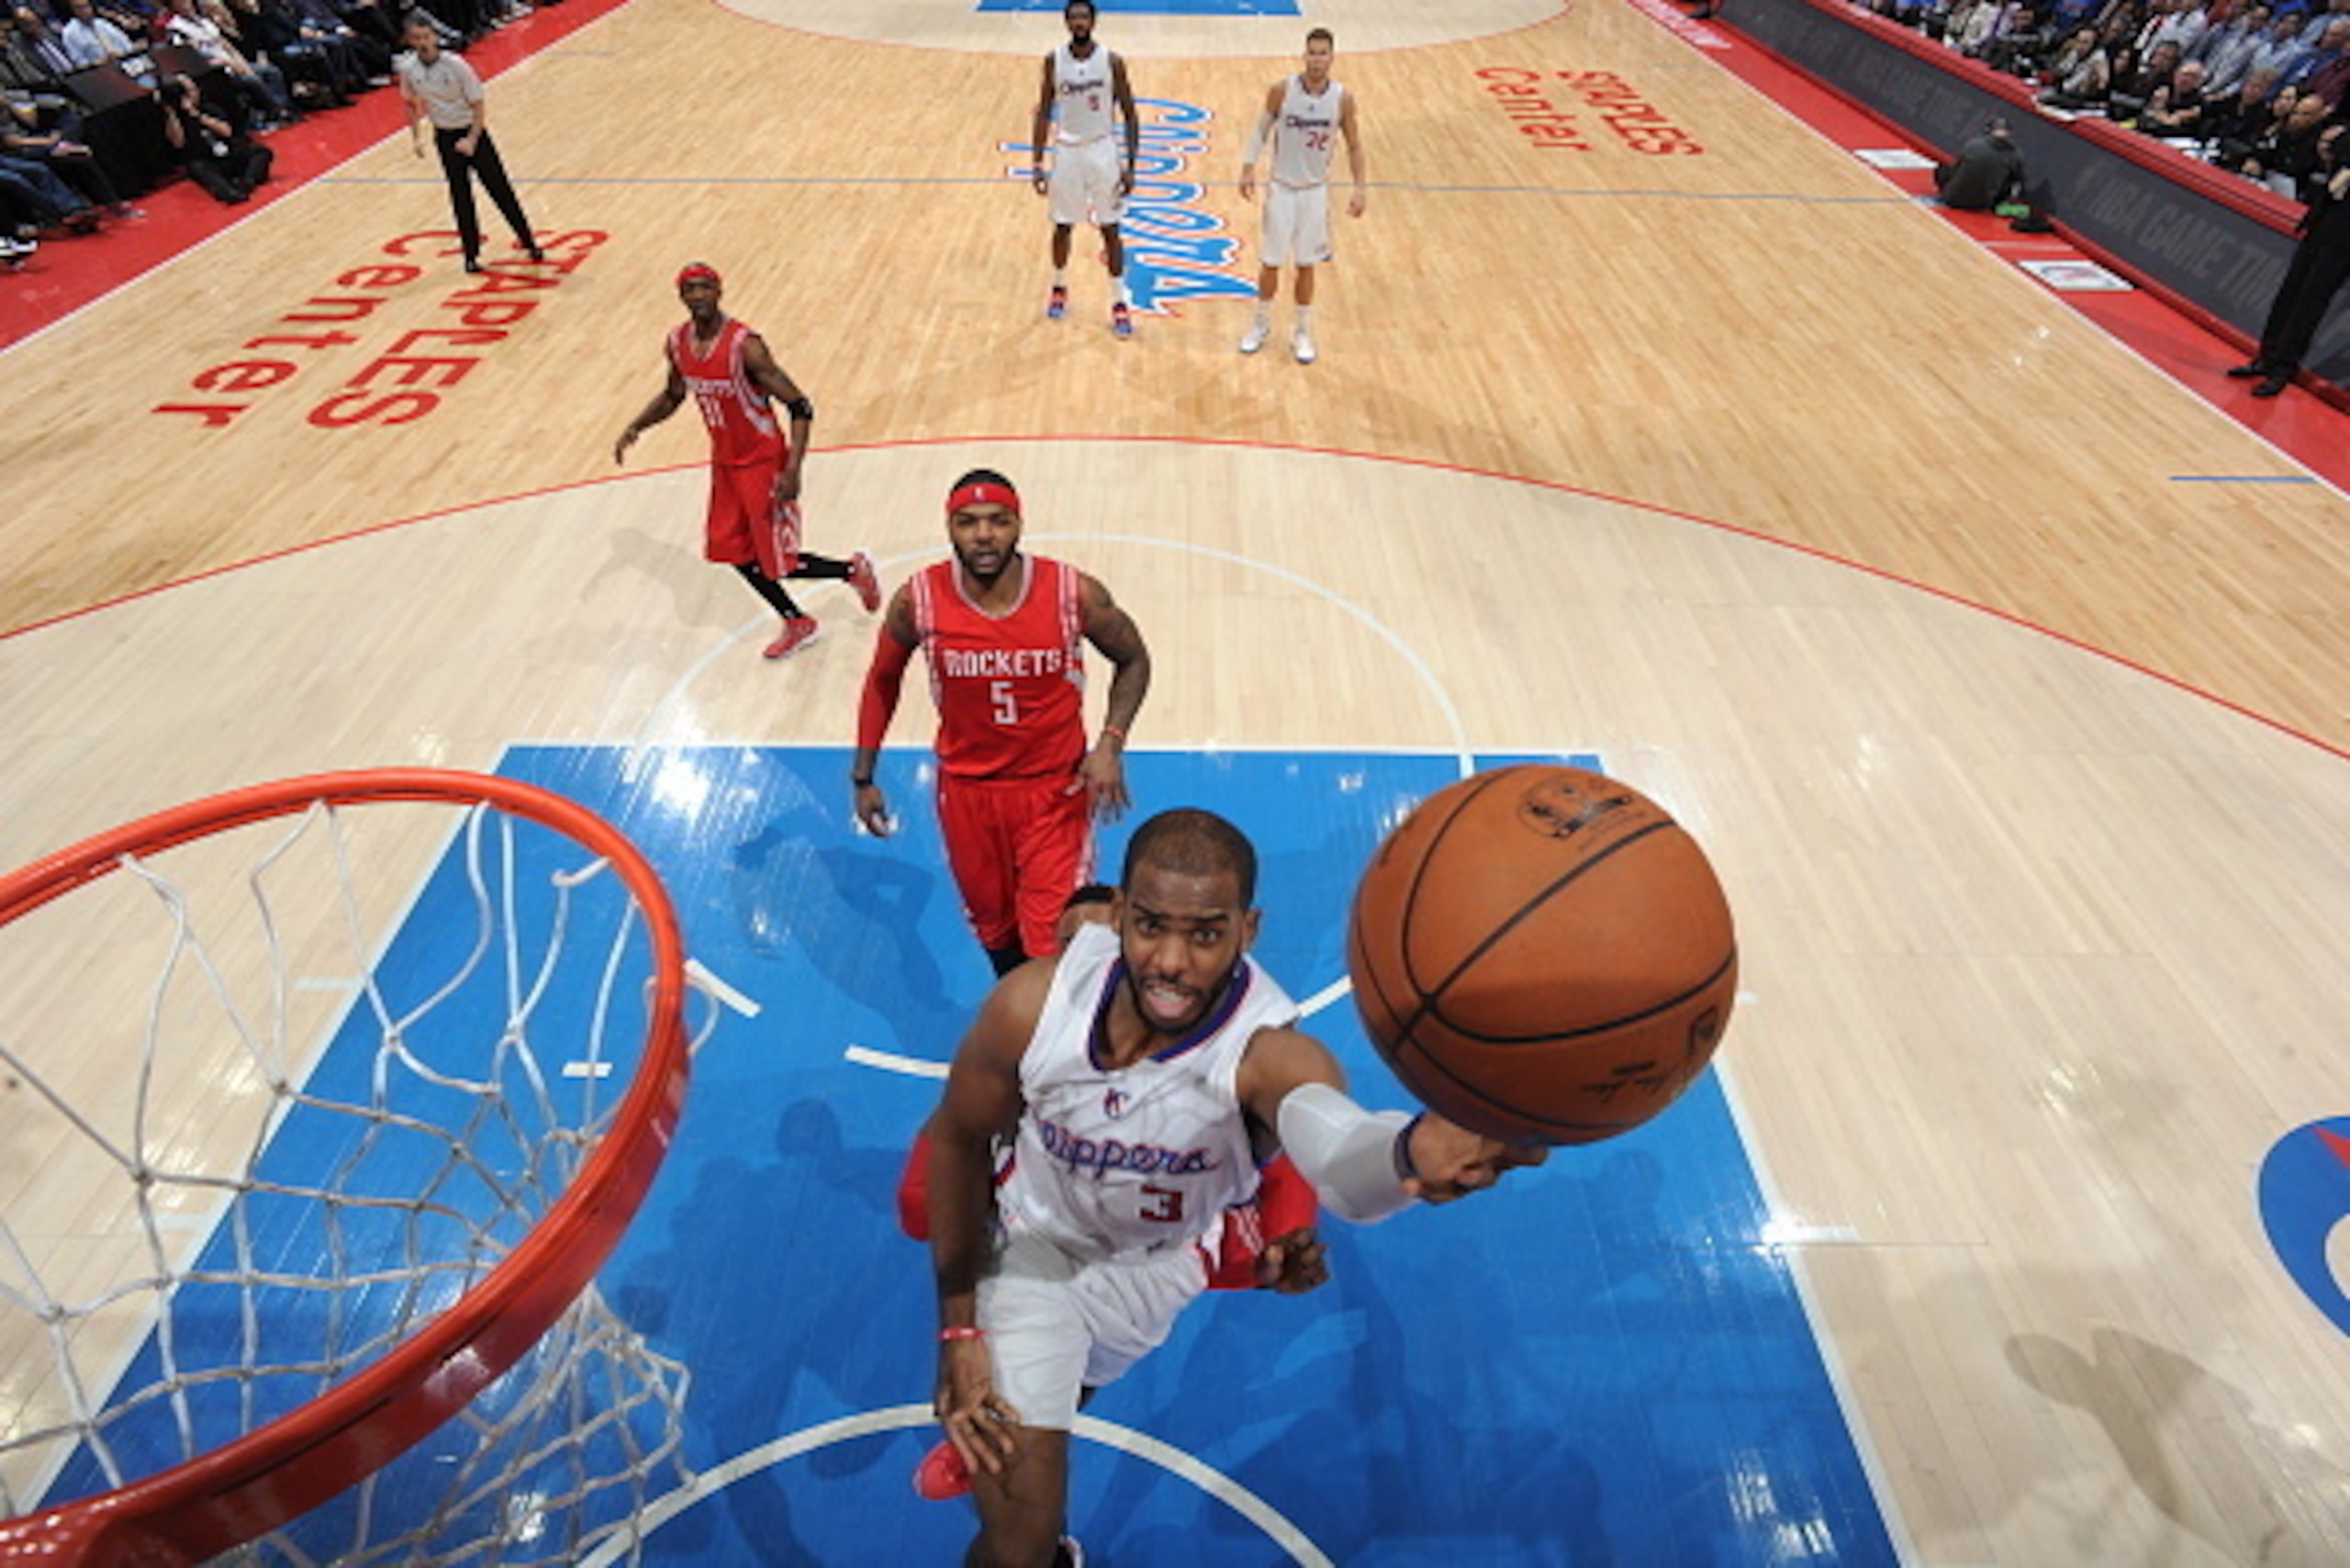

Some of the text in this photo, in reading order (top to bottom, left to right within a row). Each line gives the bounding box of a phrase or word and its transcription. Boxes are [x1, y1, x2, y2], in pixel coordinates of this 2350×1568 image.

[1474, 67, 1593, 151] Center
[1556, 71, 1701, 155] STAPLES
[2139, 202, 2237, 279] GAME
[2218, 241, 2291, 318] TIM
[151, 230, 488, 427] Center
[308, 230, 610, 429] STAPLES
[943, 648, 1061, 678] ROCKETS
[990, 680, 1019, 725] 5
[1140, 1184, 1183, 1223] 3
